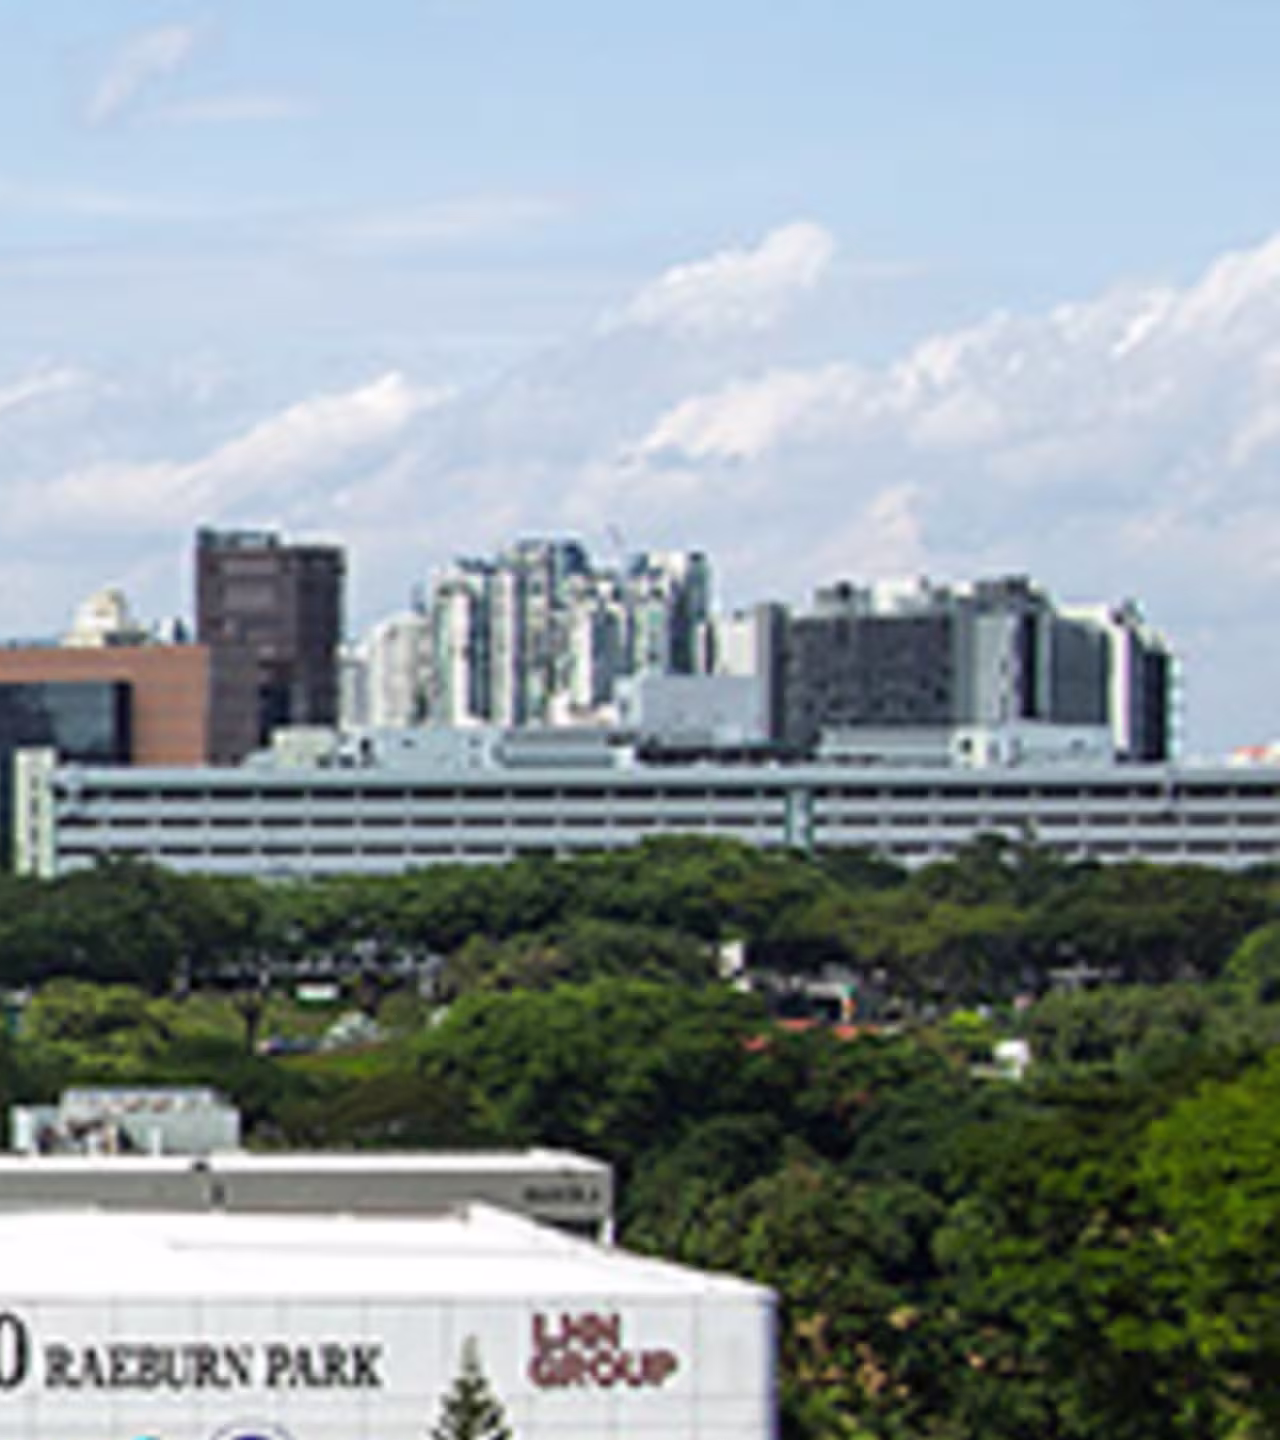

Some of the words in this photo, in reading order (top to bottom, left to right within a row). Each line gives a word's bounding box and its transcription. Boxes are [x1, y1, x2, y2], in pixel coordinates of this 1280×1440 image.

[43, 1343, 254, 1389] RAEBURN
[264, 1344, 384, 1388] PARK
[530, 1351, 678, 1388] GROUP
